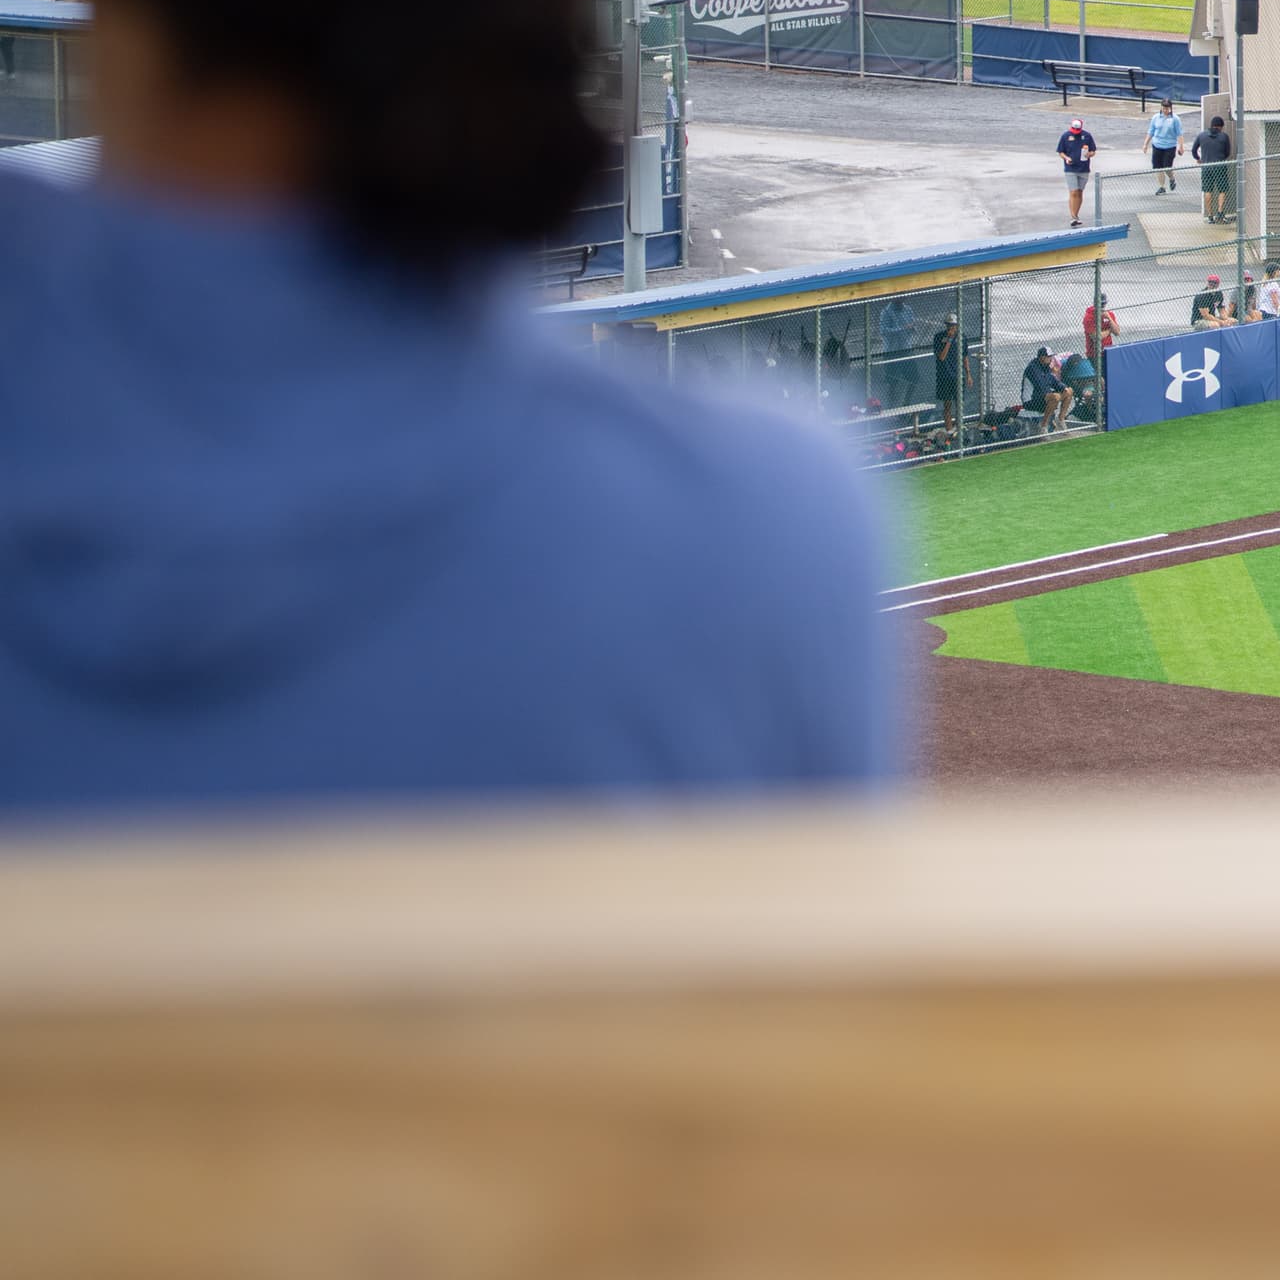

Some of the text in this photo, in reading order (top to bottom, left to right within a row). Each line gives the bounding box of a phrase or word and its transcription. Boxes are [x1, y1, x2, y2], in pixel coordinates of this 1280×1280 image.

[770, 15, 842, 32] ALL STAR VILLAGE
